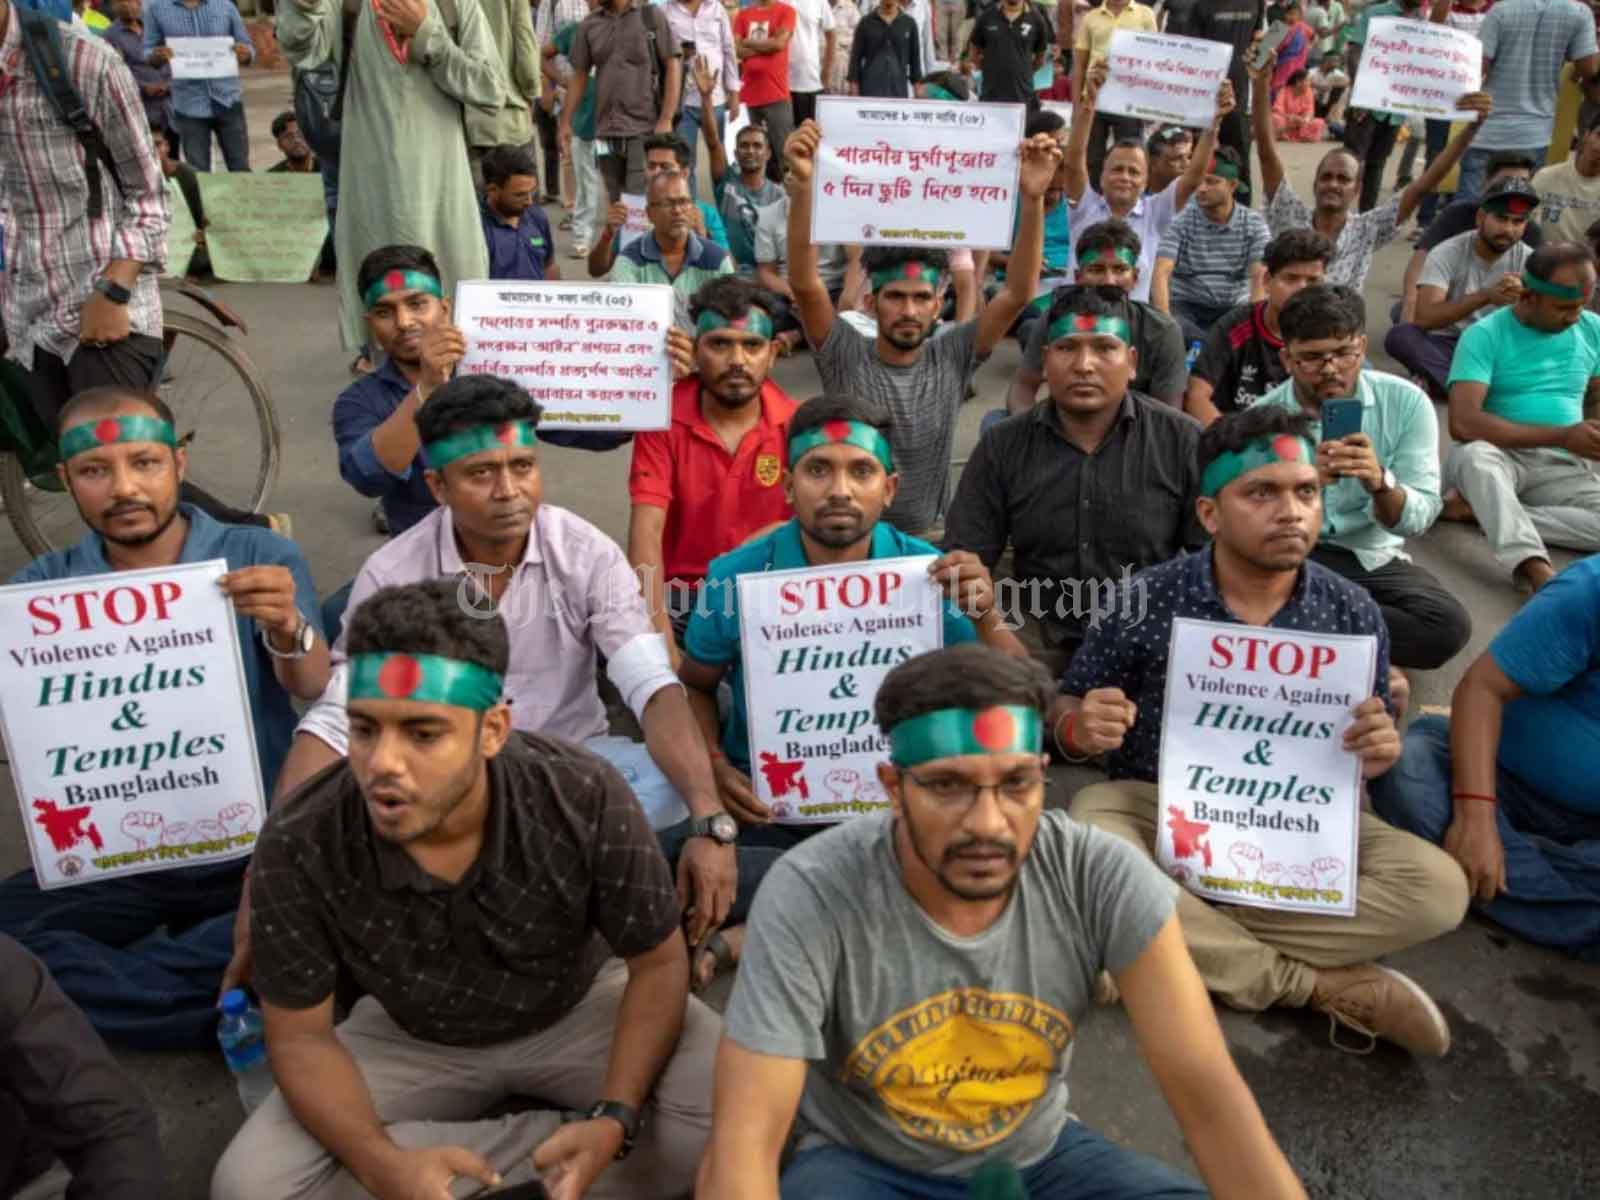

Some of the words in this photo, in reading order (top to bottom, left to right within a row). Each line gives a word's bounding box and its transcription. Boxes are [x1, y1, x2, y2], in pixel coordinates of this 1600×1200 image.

[835, 140, 904, 166] শারদীয়
[908, 145, 999, 174] দুর্গাপূজায়
[823, 179, 837, 196] ৫
[841, 175, 874, 198] দিন
[878, 176, 913, 204] ছুটি
[922, 177, 963, 202] দিতে
[27, 580, 183, 637] STOP
[780, 571, 904, 616] STOP
[760, 621, 845, 642] Violence
[849, 612, 925, 635] Against
[10, 639, 117, 669] Violence
[124, 625, 215, 656] Against
[775, 641, 913, 675] Hindus
[1208, 634, 1338, 679] STOP
[37, 662, 206, 708] Hindus
[829, 673, 860, 700] &
[1185, 673, 1269, 699] Violence
[1274, 684, 1352, 707] Against
[110, 700, 149, 732] &
[775, 706, 880, 735] Temp
[1192, 701, 1336, 740] Hindus
[46, 730, 227, 779] Temples
[1242, 738, 1275, 767] &
[64, 765, 220, 805] Bangladesh
[1185, 765, 1336, 806] Temples
[1193, 800, 1321, 834] Bangladesh
